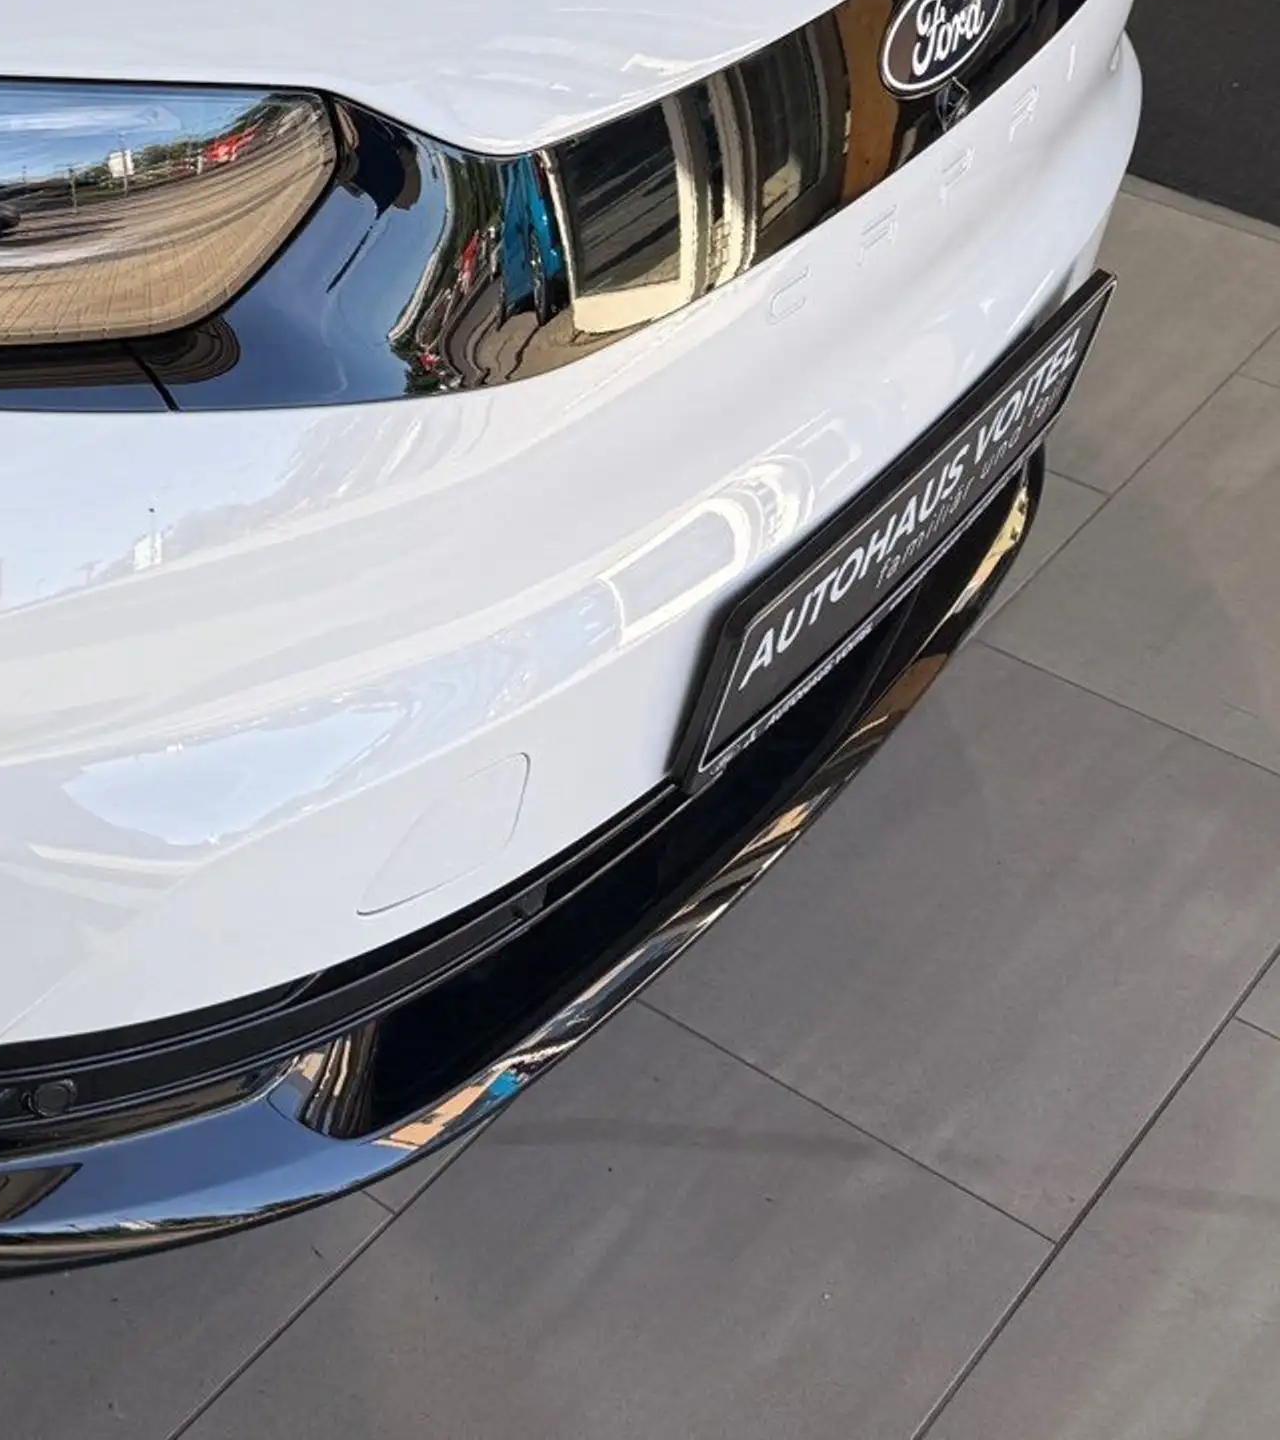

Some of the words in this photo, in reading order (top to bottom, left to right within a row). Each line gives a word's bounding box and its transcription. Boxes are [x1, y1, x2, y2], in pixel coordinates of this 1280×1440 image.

[766, 40, 1078, 327] CAPRI
[739, 444, 971, 691] AUTOHAUS
[974, 327, 1081, 465] VOITEL
[875, 475, 976, 589] familiär
[980, 415, 1026, 480] und
